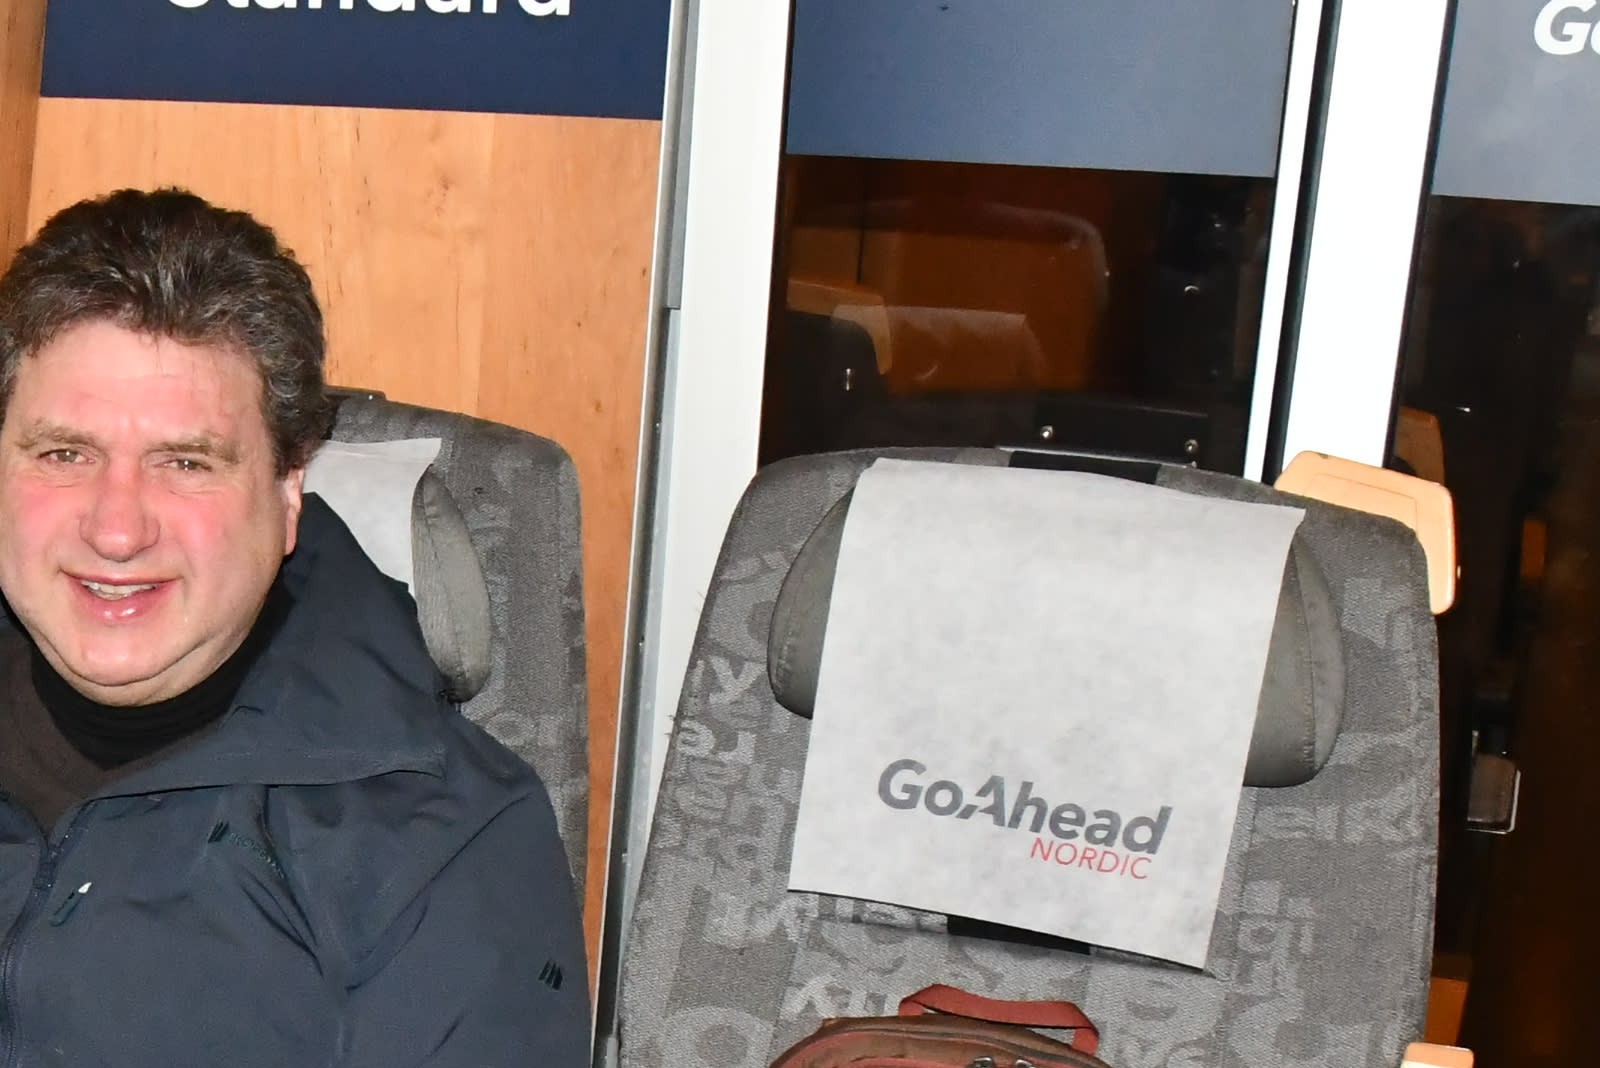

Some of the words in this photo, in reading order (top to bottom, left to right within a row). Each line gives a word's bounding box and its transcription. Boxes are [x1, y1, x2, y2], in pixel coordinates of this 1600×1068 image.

[1534, 0, 1600, 55] G
[877, 758, 1173, 855] GoAhead
[1030, 837, 1152, 879] NORDIC
